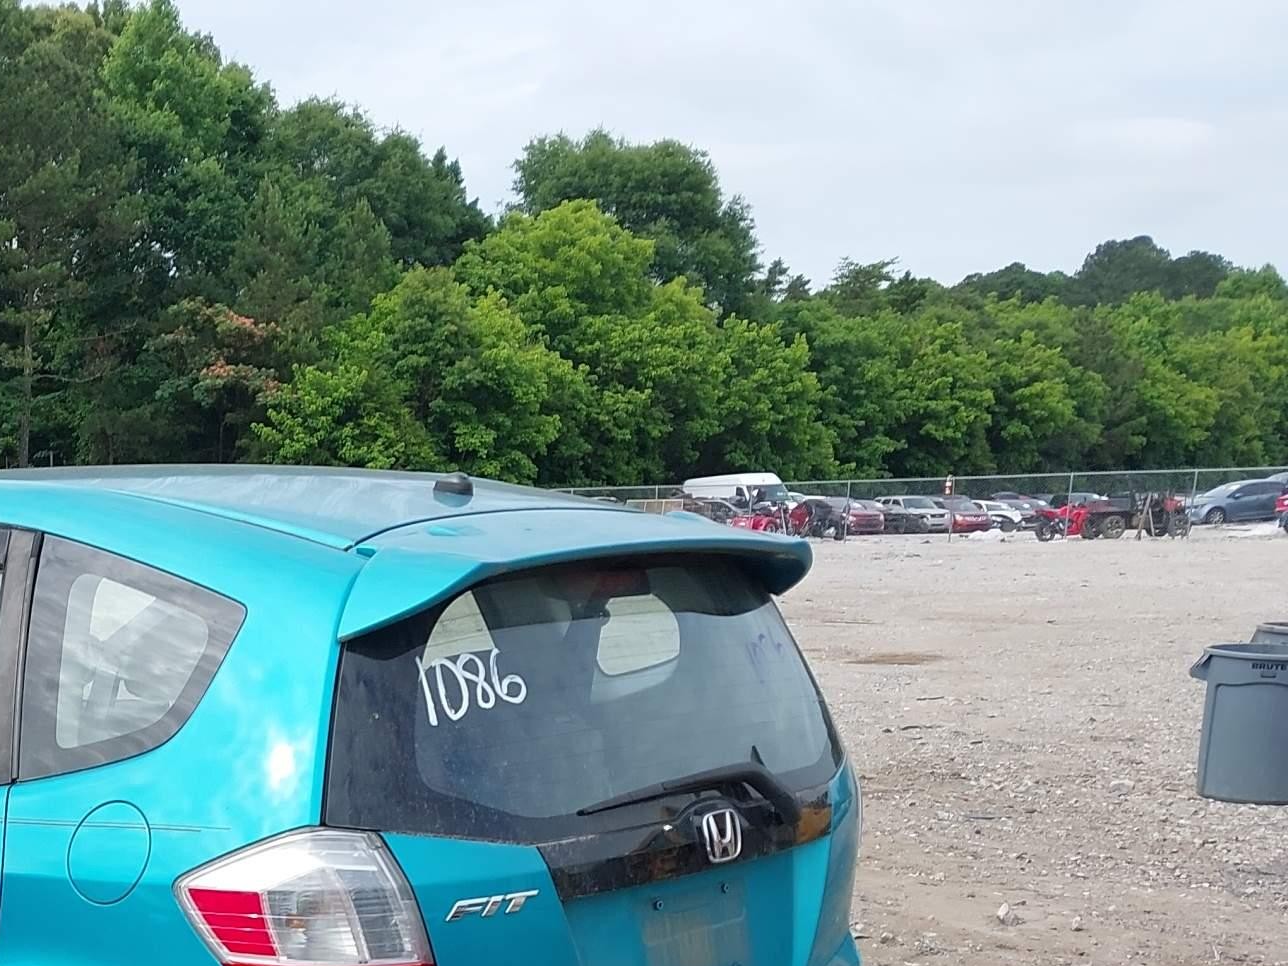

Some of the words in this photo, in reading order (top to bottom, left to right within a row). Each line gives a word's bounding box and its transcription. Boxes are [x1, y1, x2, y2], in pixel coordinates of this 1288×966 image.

[1252, 663, 1287, 671] BRUTE
[415, 647, 527, 727] 1086
[445, 889, 540, 922] FIT
